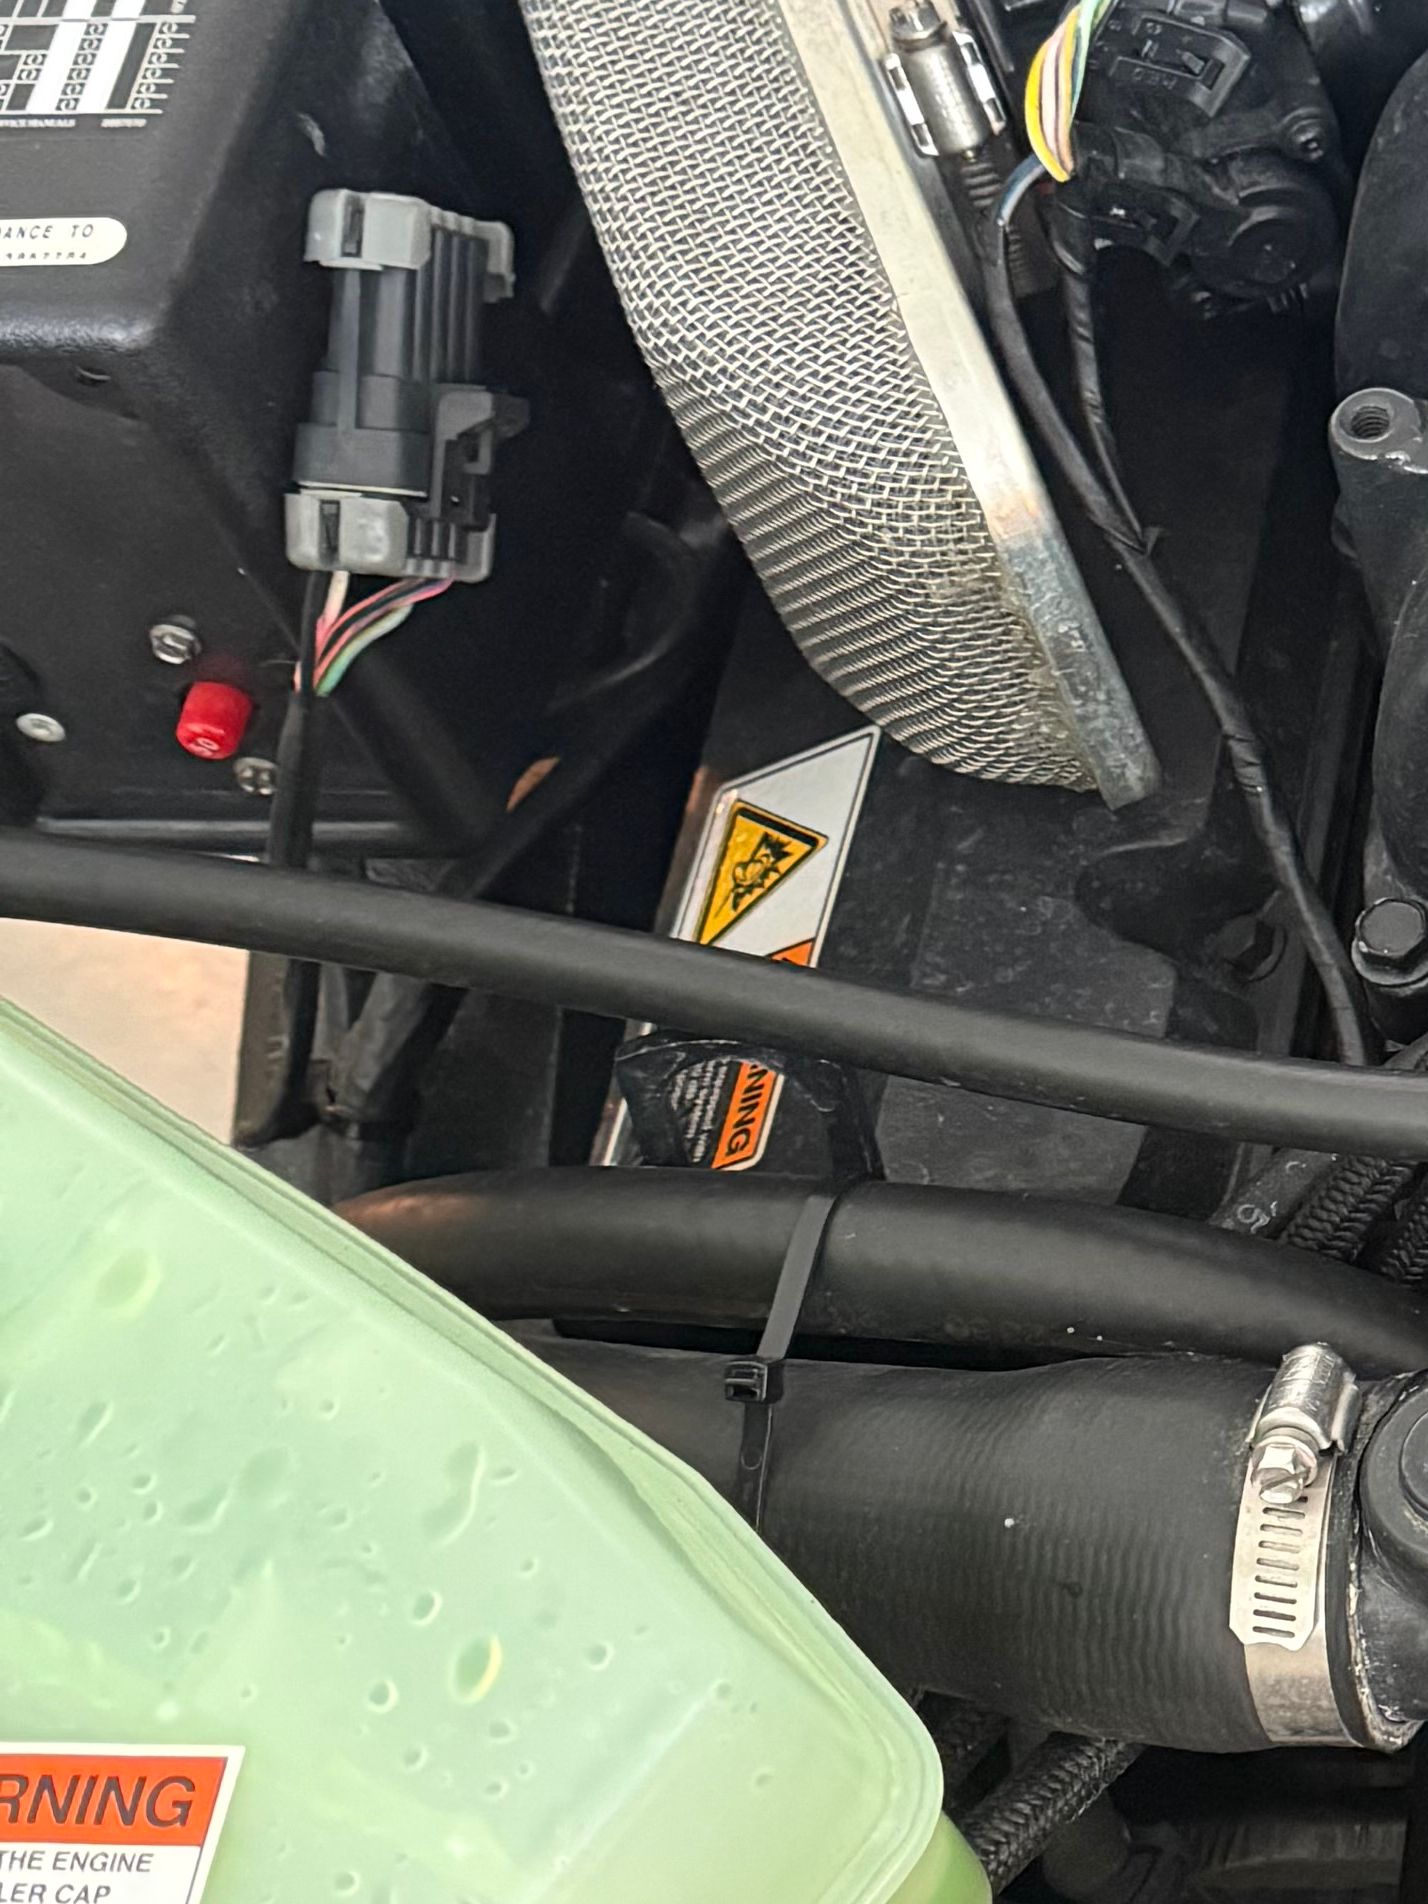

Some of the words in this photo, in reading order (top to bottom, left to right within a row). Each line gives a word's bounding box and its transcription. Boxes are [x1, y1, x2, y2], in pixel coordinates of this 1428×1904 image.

[0, 225, 53, 239] ANCE
[71, 224, 94, 238] TO
[724, 1062, 769, 1156] NING
[0, 1850, 45, 1871] THE
[52, 1851, 154, 1873] ENGINE
[55, 1883, 112, 1904] CAP
